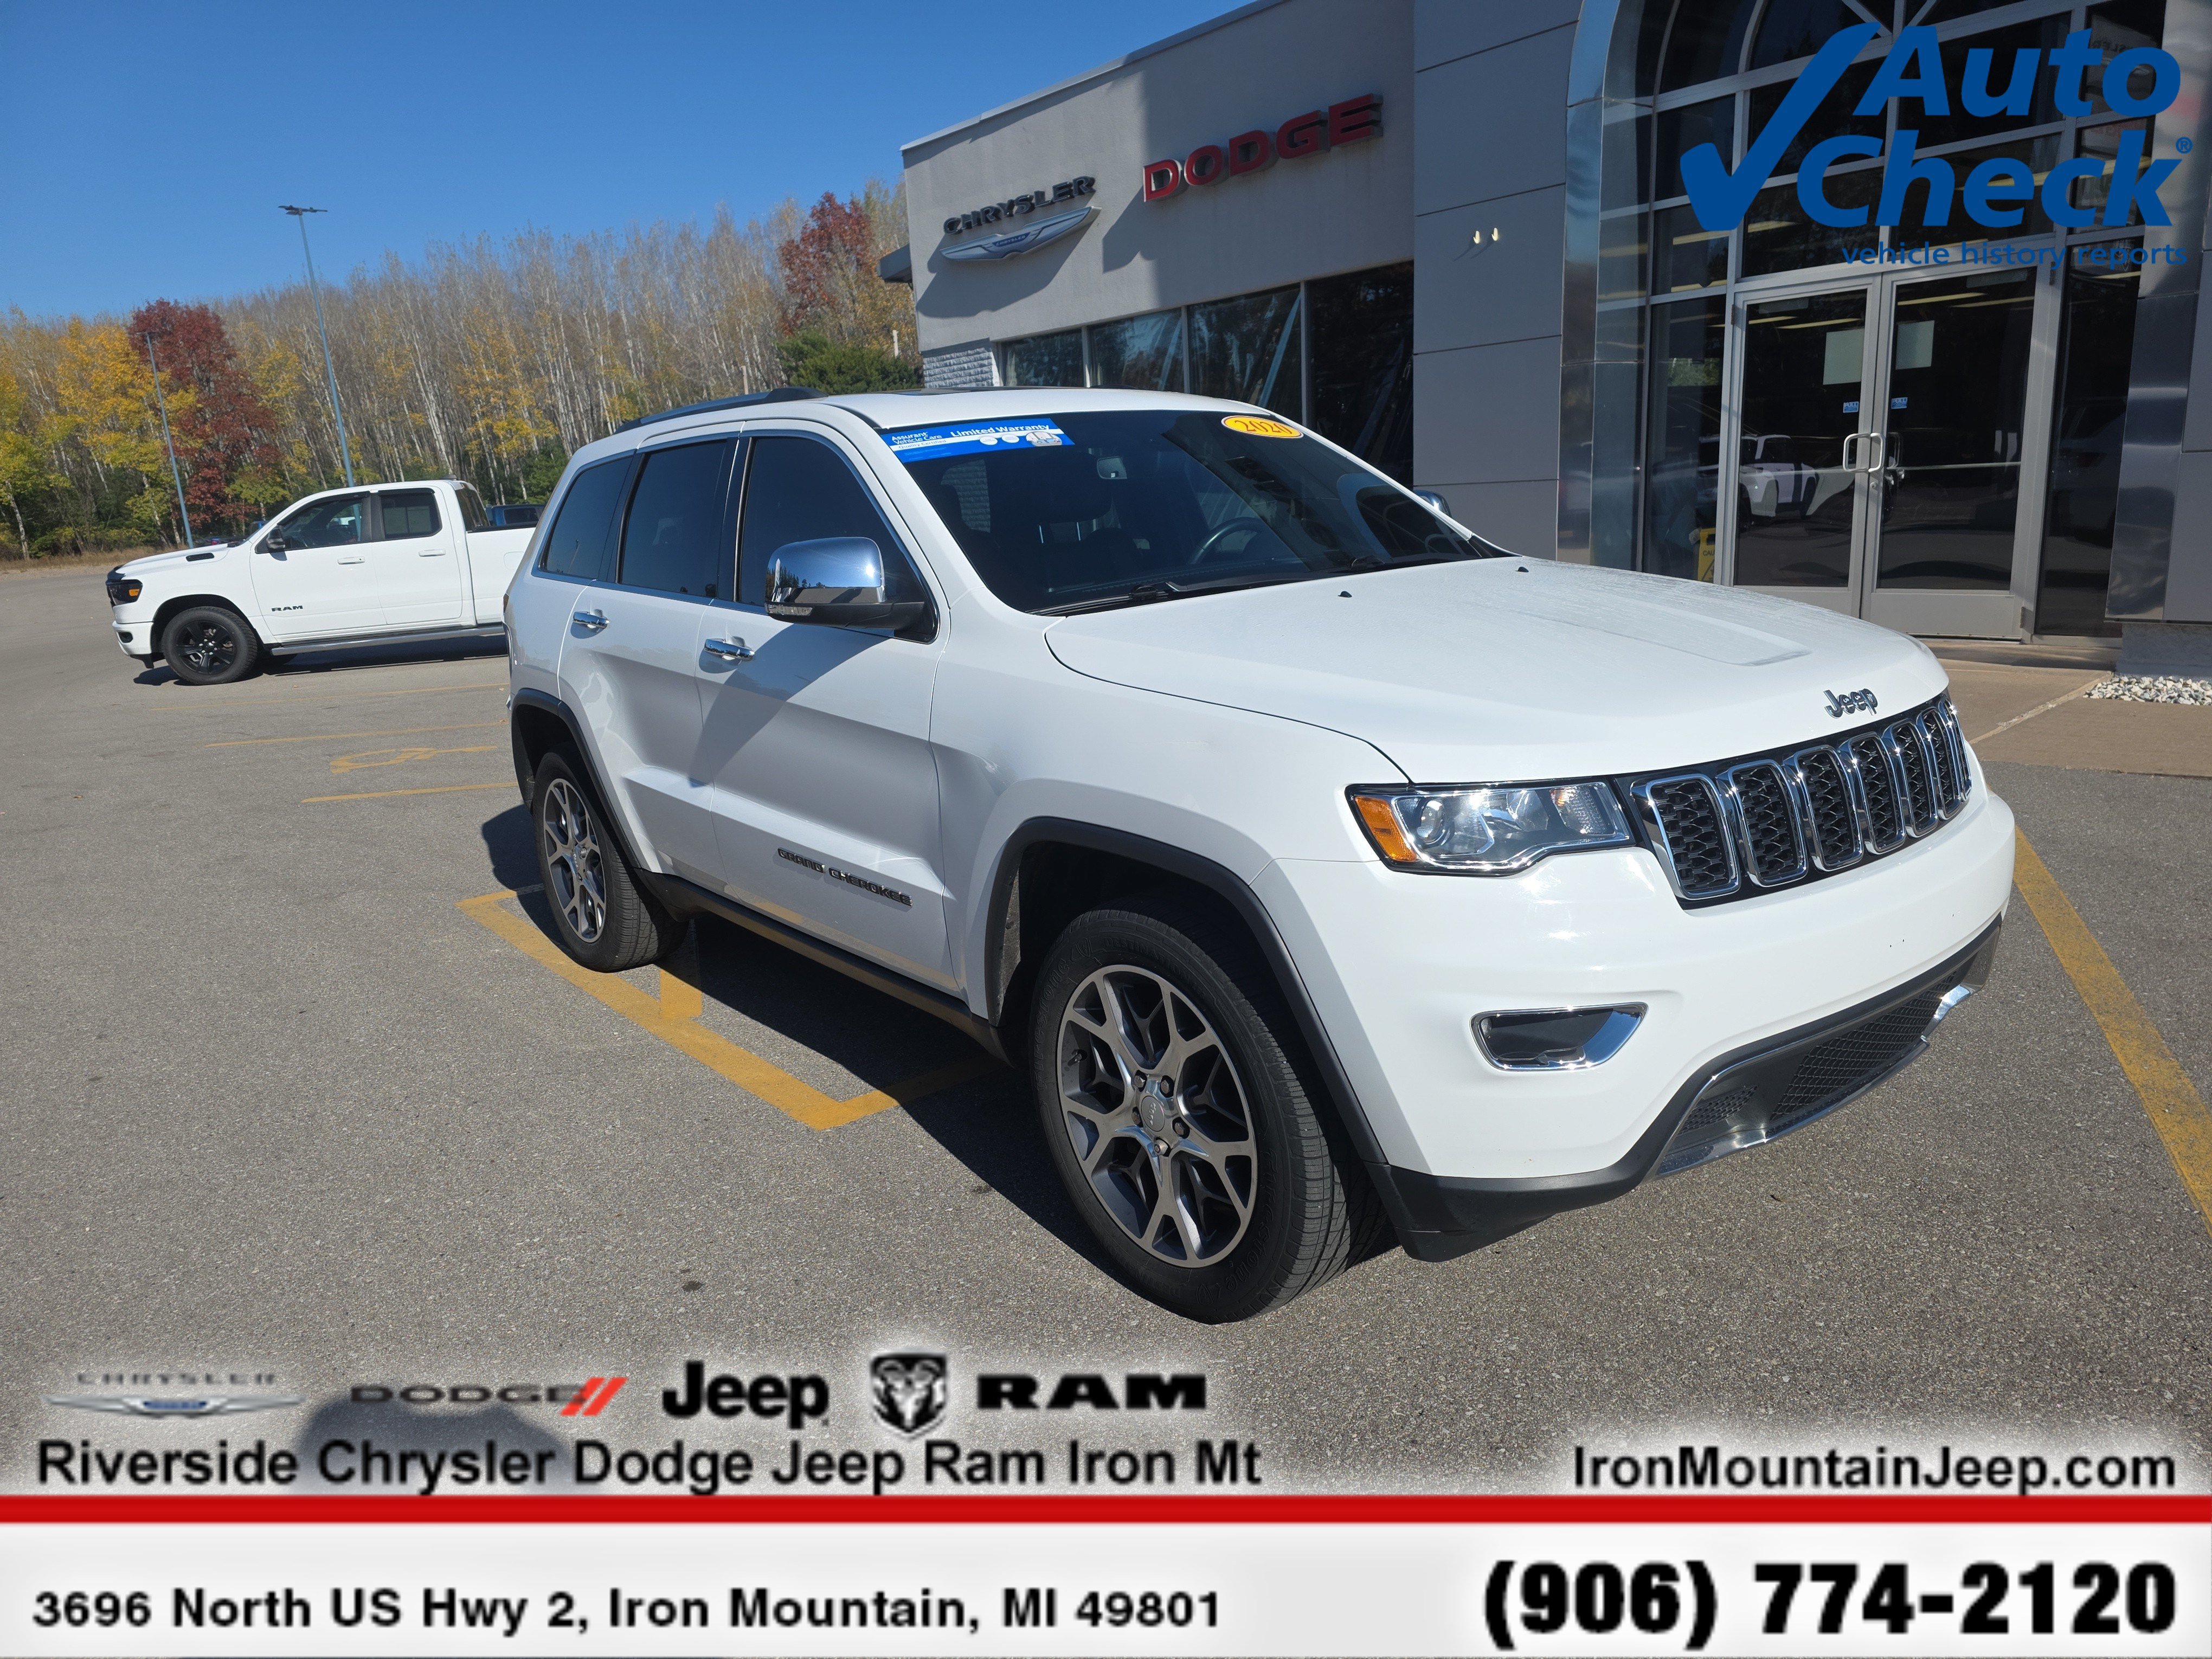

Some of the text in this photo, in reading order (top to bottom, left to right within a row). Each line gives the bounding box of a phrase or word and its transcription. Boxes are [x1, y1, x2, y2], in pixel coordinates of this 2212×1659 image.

[1142, 93, 1384, 202] DODGE
[943, 175, 1096, 234] CHRYSLER
[892, 431, 928, 441] Assurant
[950, 424, 1050, 438] Limited Warranty
[1234, 420, 1293, 434] 2020
[1823, 688, 1878, 719] Jeep
[777, 847, 913, 907] GRAND CHEROKEE
